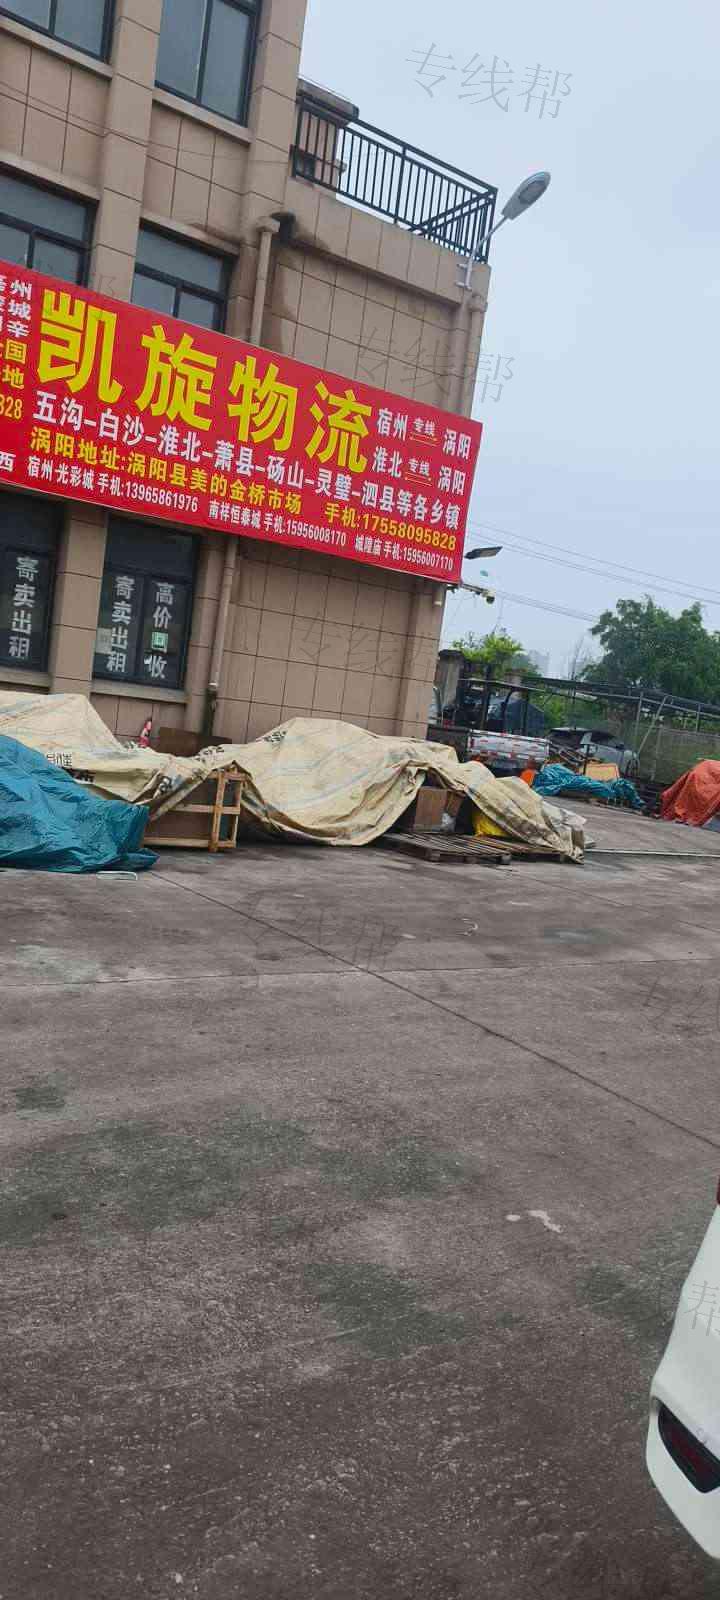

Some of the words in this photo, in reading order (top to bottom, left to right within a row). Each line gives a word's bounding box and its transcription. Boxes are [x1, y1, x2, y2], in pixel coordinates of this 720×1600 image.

[0, 315, 29, 338] 辛
[0, 338, 27, 364] 国
[0, 365, 25, 389] 地
[37, 288, 372, 474] 凯旋物流
[376, 408, 408, 441] 宿州
[412, 417, 436, 437] 专线
[442, 428, 472, 460] 涡阳
[97, 472, 199, 513] 手机:13965861976
[372, 446, 402, 479] 淮北
[407, 458, 430, 477] 专线
[437, 466, 466, 497] 涡阳
[325, 502, 457, 550] 手机:17558095828
[8, 556, 39, 658] 寄卖出租
[106, 576, 135, 672] 寄卖出租
[144, 582, 175, 679] 高价回收
